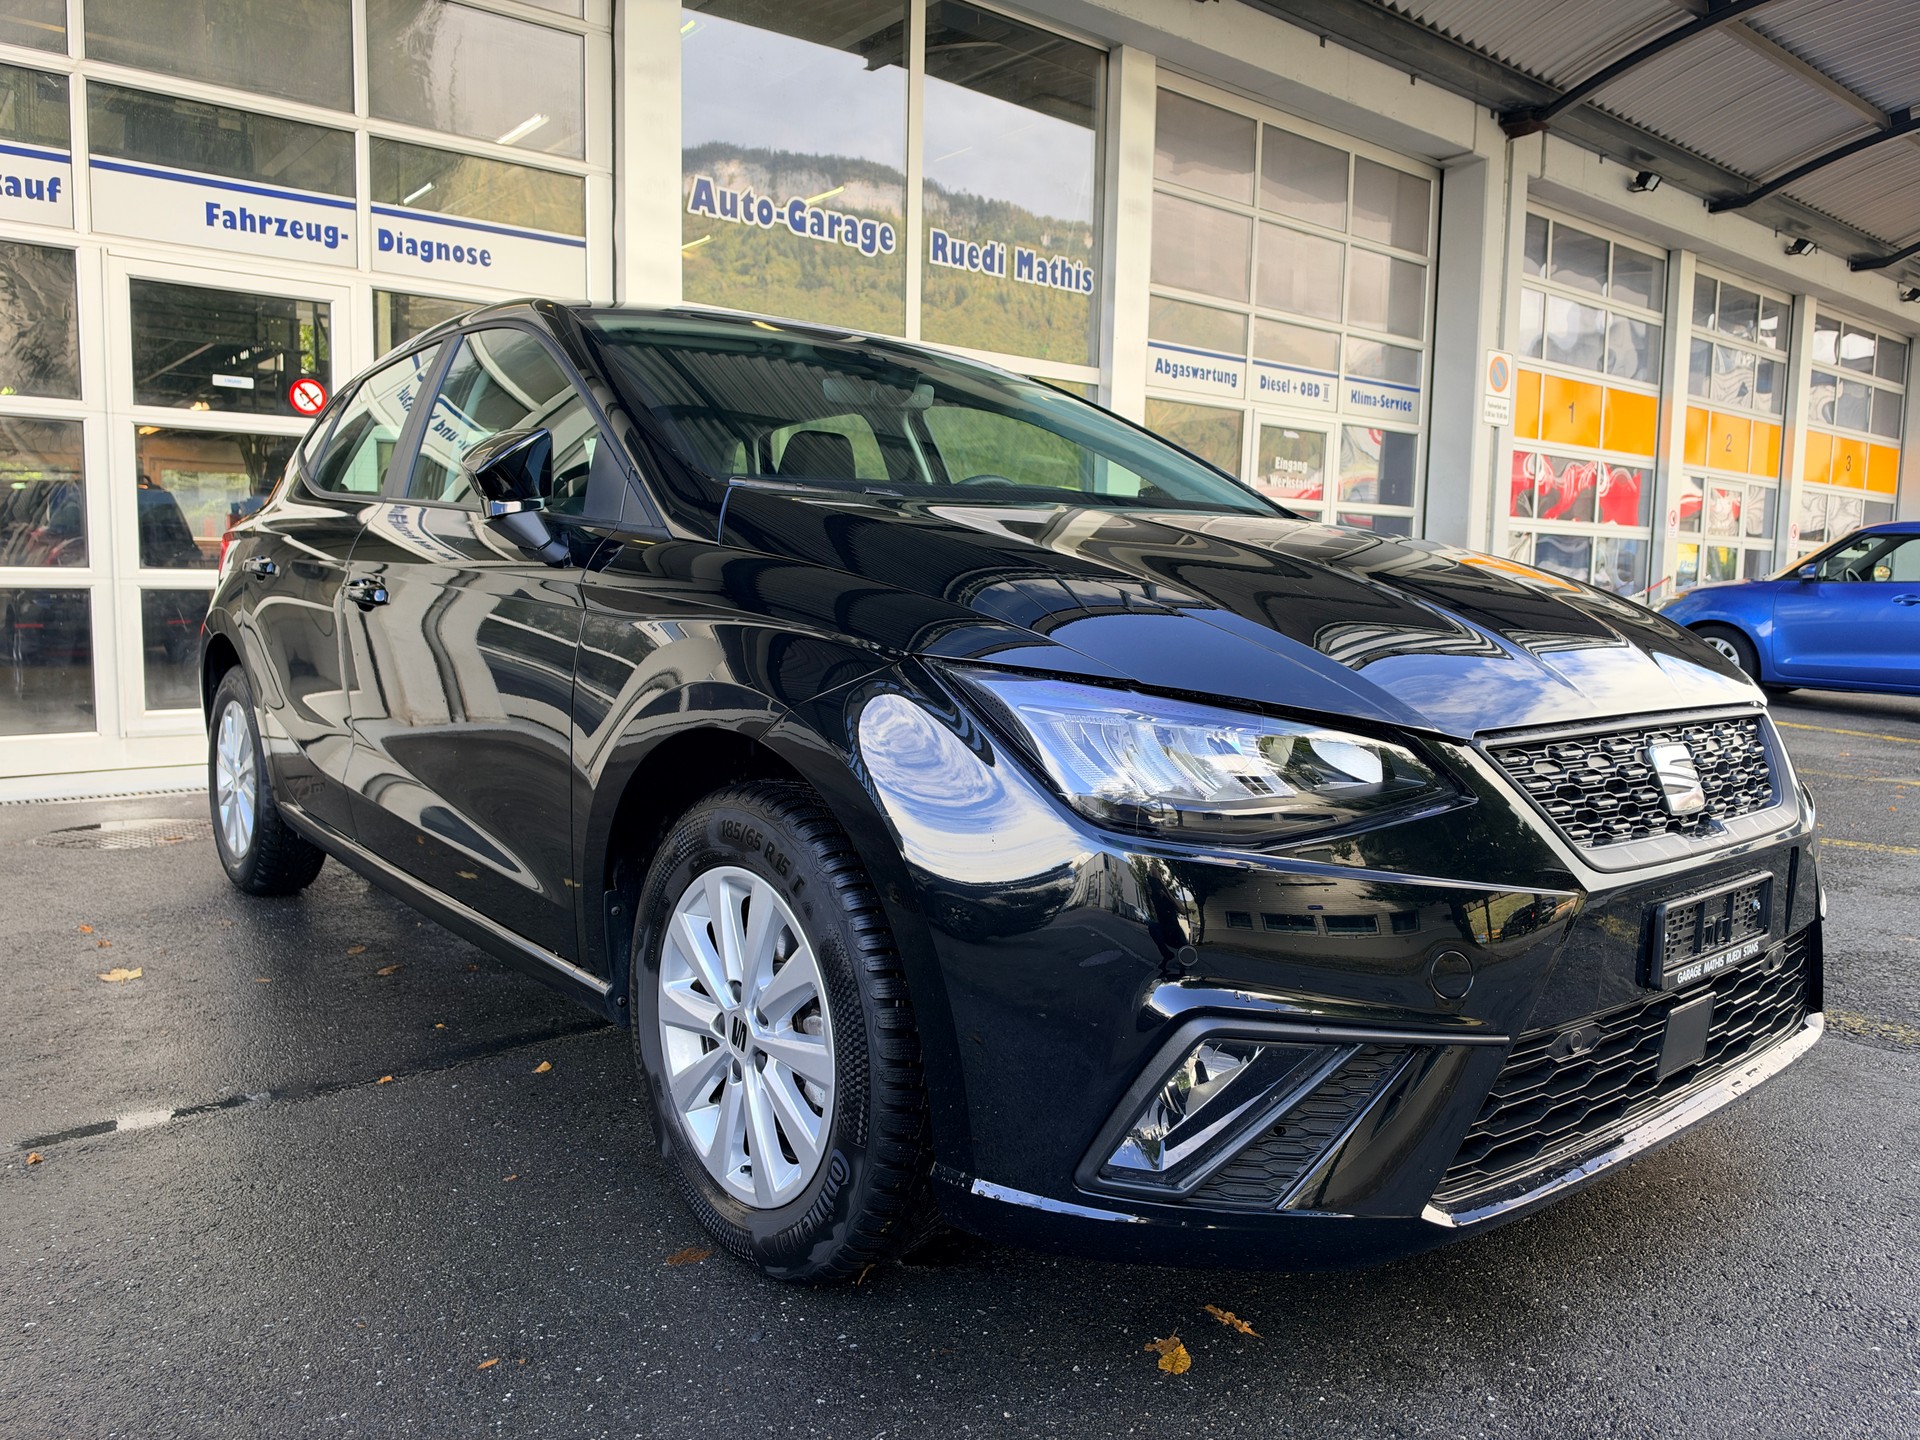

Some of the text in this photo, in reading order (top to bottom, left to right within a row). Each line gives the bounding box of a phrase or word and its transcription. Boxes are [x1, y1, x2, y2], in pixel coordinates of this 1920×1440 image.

[0, 174, 61, 203] auf
[688, 174, 896, 258] Auto-Garage
[206, 201, 493, 267] Fahrzeug- Diagnose
[929, 227, 1095, 296] Ruedi Mathis
[1155, 357, 1238, 388] Abgaswartung
[1260, 374, 1290, 394] Diesel
[1300, 381, 1320, 398] OBD
[1350, 389, 1413, 412] Klima-Service
[1568, 401, 1575, 424] 1
[1724, 433, 1733, 453] 2
[1274, 456, 1308, 474] Eingang
[1845, 454, 1852, 472] 3
[721, 819, 764, 872] 185/65
[1677, 941, 1759, 984] GARAGE MATHIS RUEDI STANS
[773, 1148, 851, 1257] Continental
